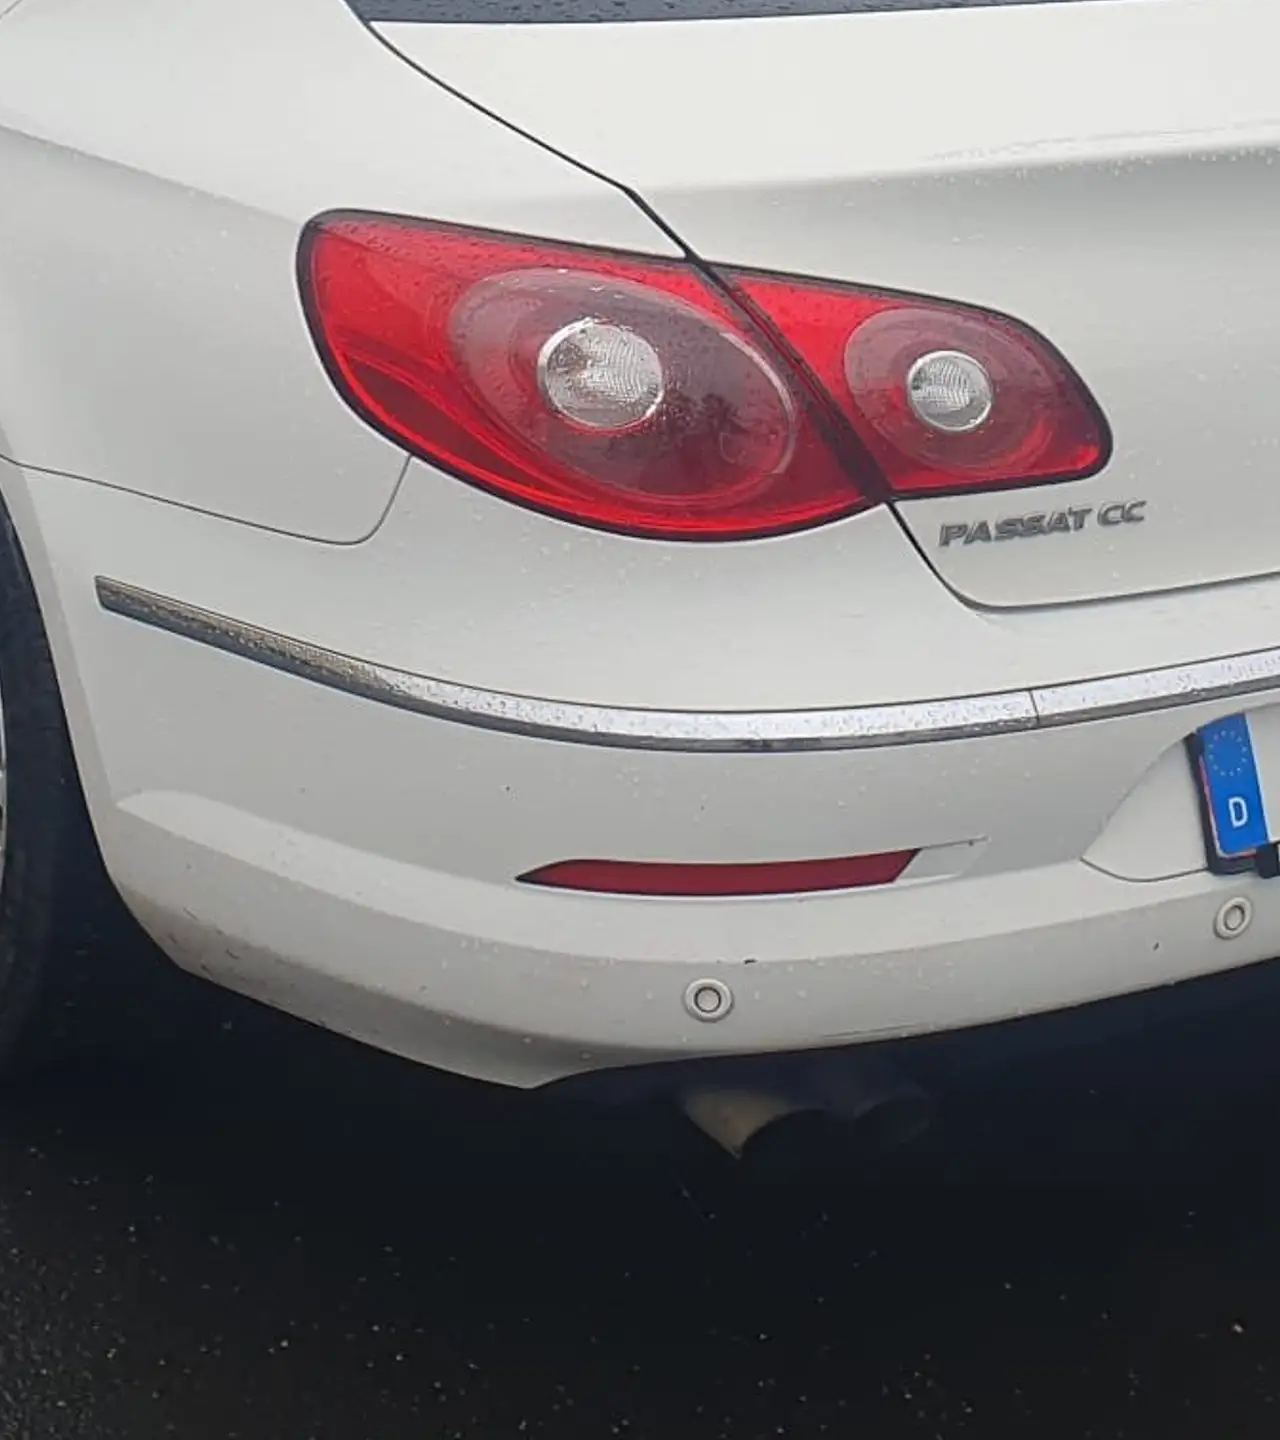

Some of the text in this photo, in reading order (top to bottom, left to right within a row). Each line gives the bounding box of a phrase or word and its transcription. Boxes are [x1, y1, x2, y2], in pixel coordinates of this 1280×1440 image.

[939, 500, 1147, 547] PASSAT CC
[1228, 795, 1249, 830] D
